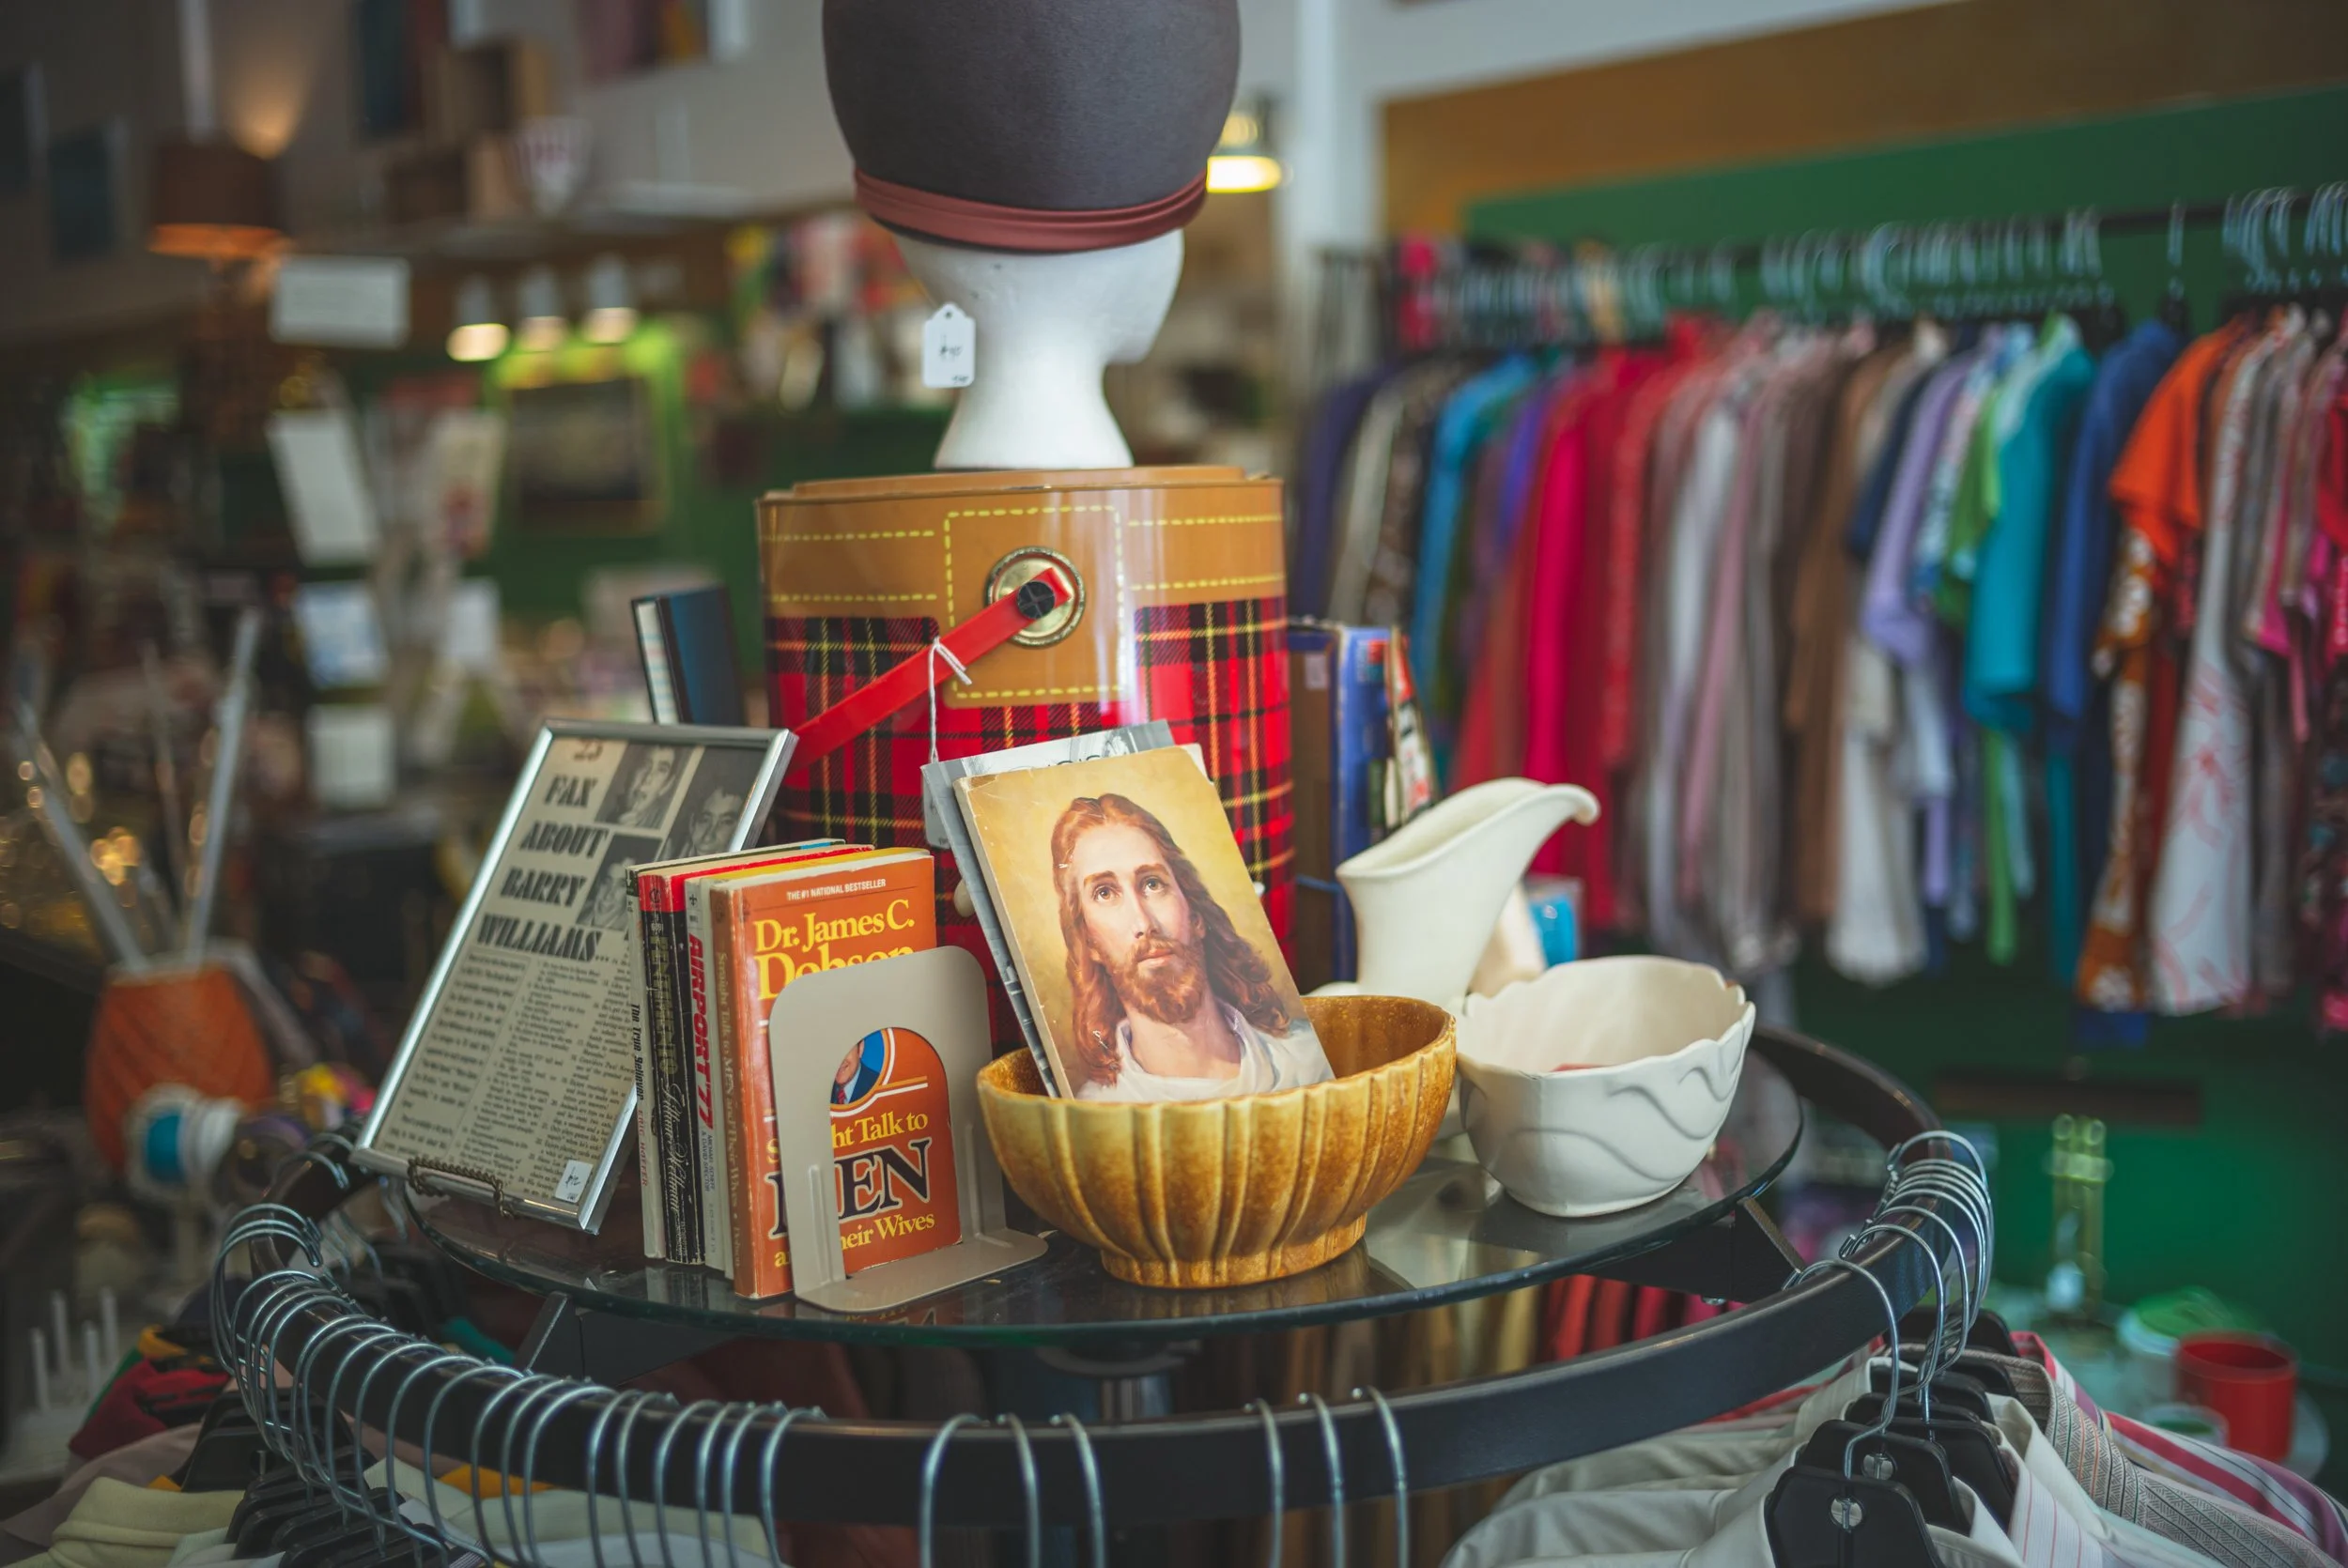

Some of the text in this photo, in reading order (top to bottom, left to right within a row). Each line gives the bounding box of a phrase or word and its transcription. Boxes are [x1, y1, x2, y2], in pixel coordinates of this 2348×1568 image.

[544, 774, 597, 807] FAX
[519, 820, 610, 859] ABOUT
[500, 865, 587, 907] BARRY
[787, 890, 800, 901] THE
[811, 885, 844, 898] NATIONAL
[845, 879, 886, 894] BESTSELLER
[754, 899, 915, 952] Dr. James C.
[718, 952, 730, 1005] Straight
[721, 1007, 732, 1037] Talk
[631, 1004, 644, 1100] The True Believer
[723, 1040, 731, 1053] to
[723, 1057, 734, 1095] MEN
[660, 1078, 683, 1140] Lillian
[727, 1099, 736, 1125] and
[856, 1111, 928, 1144] Talk to
[640, 1143, 648, 1186] HOFFER
[727, 1127, 737, 1165] Their
[665, 1141, 687, 1215] Hellman
[730, 1167, 739, 1207] Wives
[873, 1214, 935, 1239] Wives
